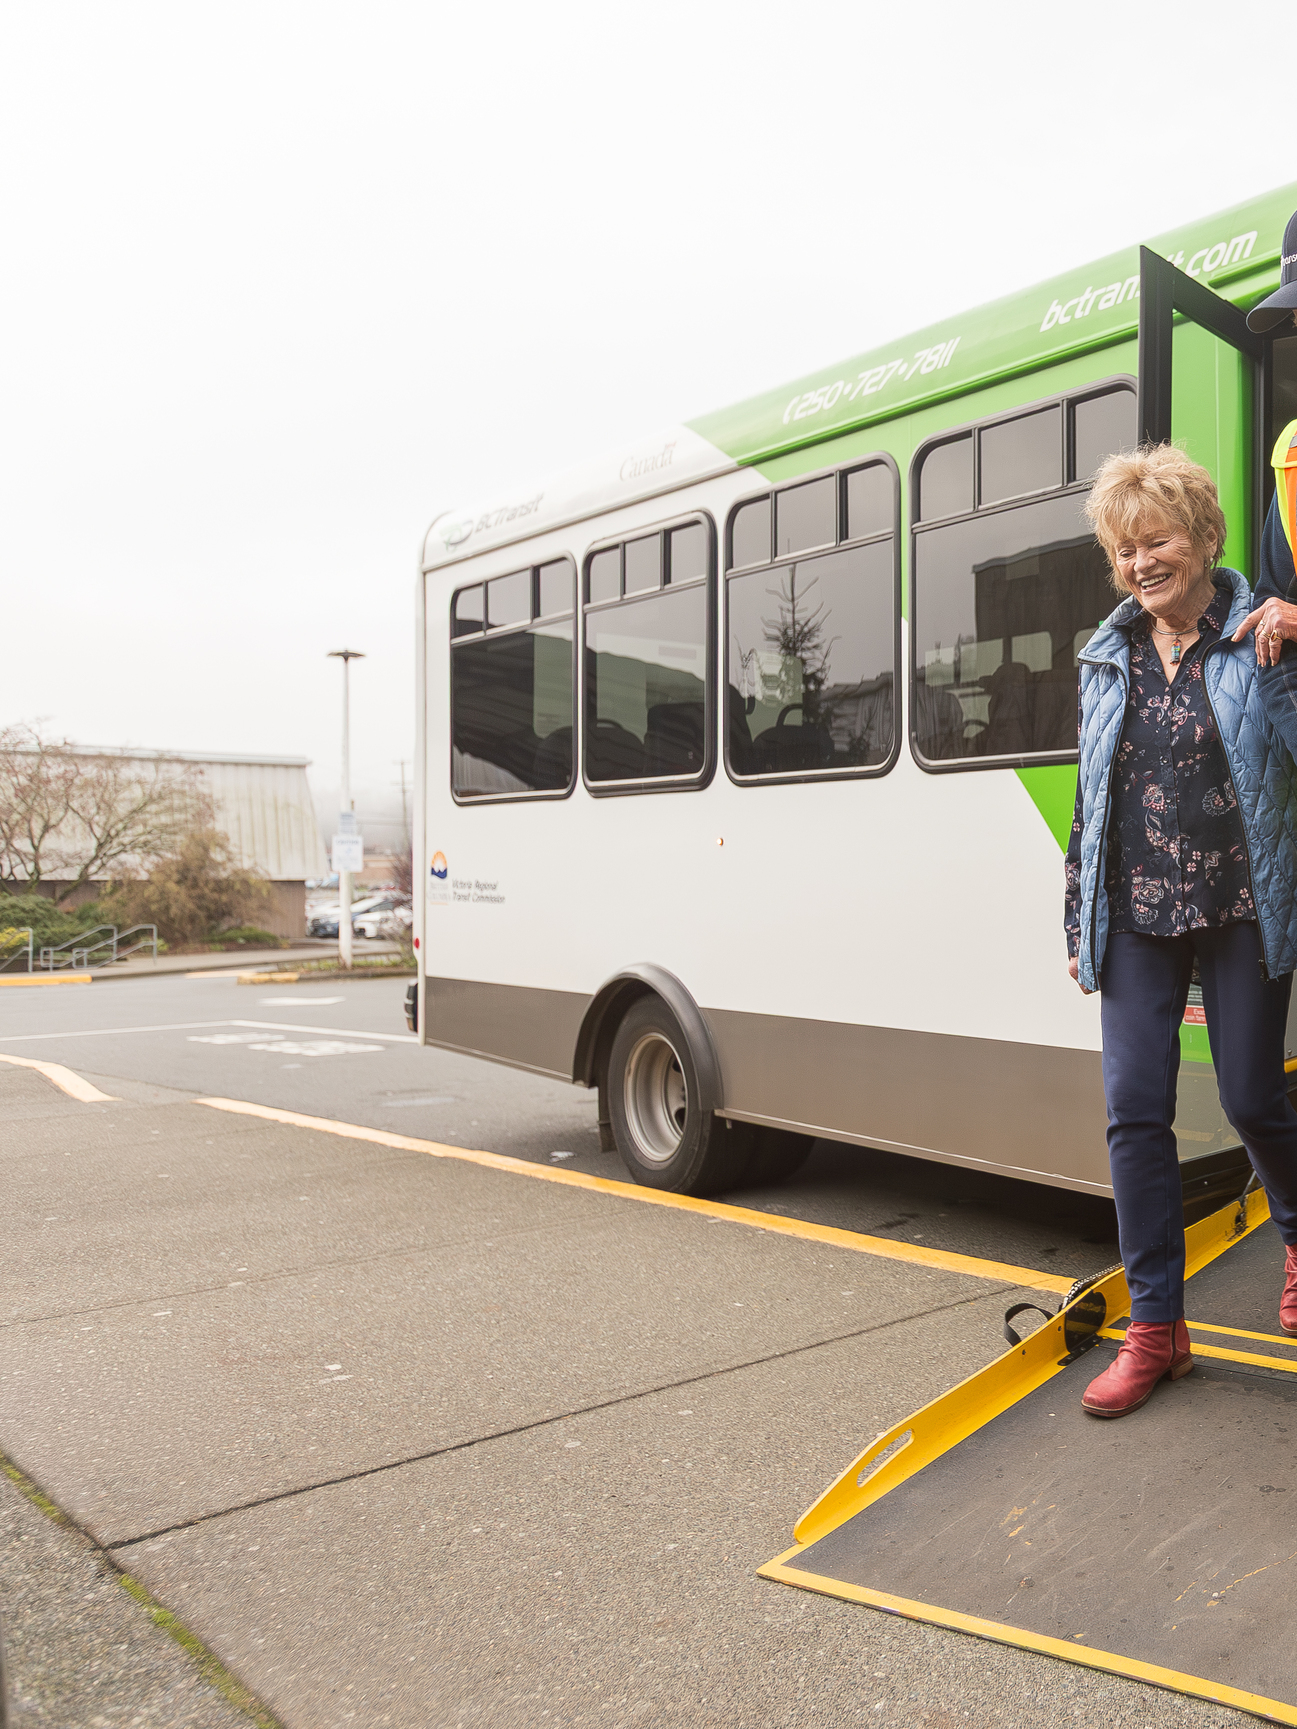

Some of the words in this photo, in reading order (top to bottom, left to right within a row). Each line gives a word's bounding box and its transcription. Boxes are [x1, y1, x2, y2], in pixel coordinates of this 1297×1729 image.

[1039, 230, 1258, 333] bctrantcom
[619, 442, 675, 482] Canada
[475, 492, 545, 533] BCTransit
